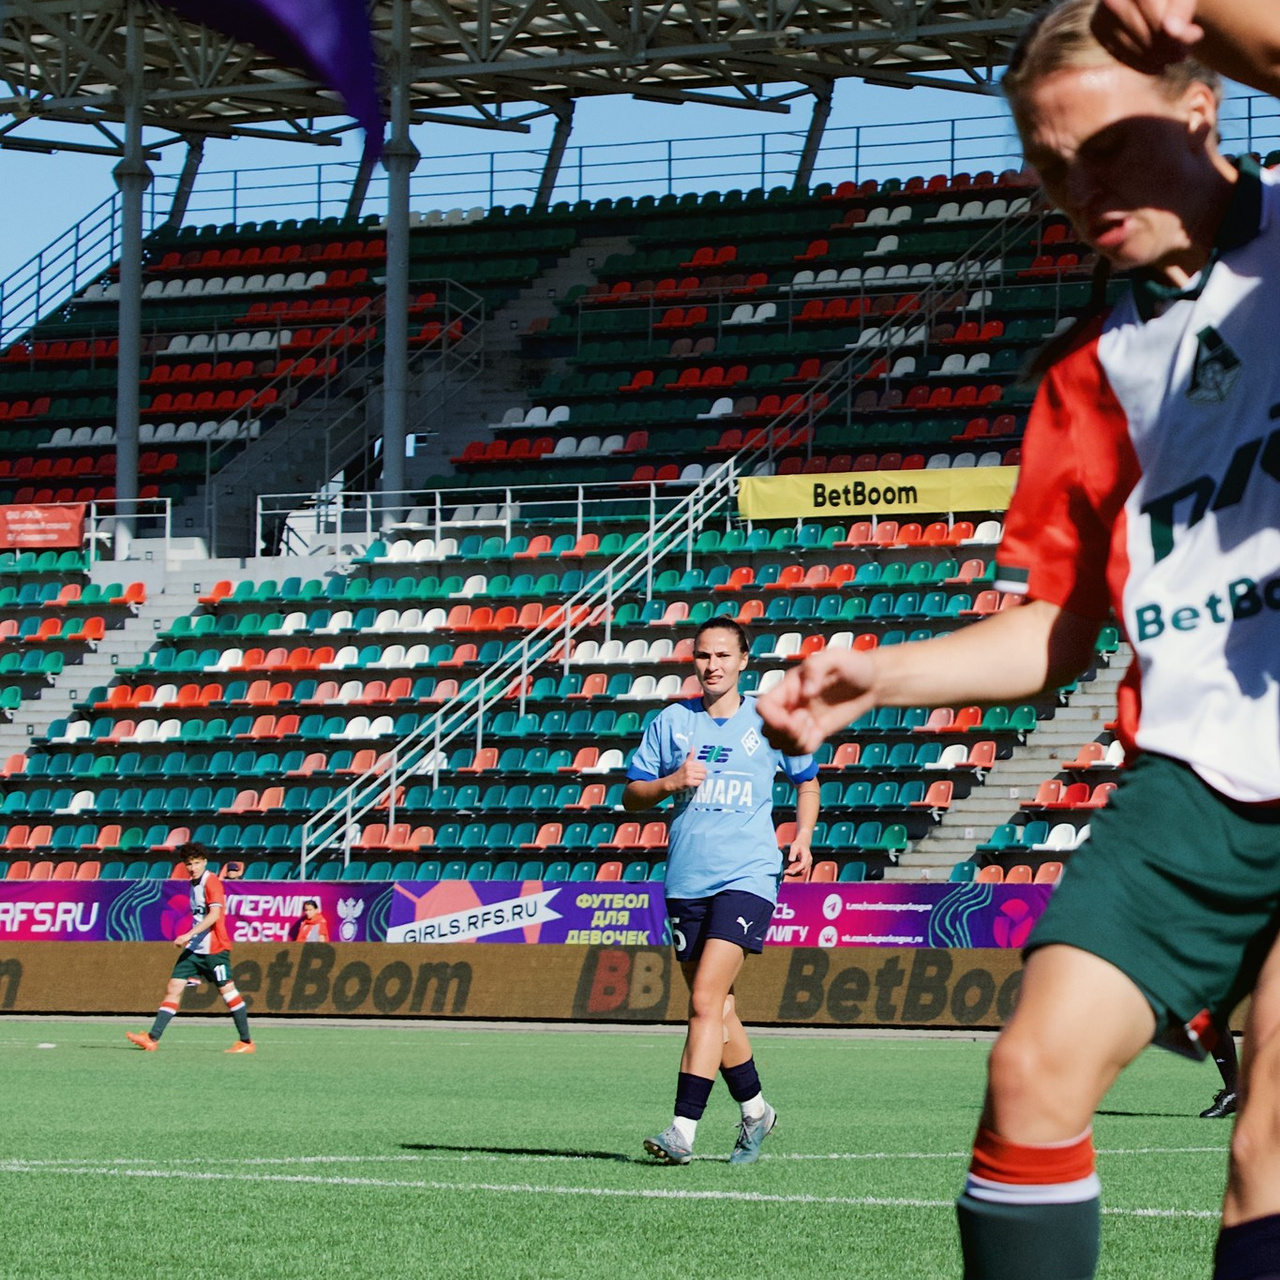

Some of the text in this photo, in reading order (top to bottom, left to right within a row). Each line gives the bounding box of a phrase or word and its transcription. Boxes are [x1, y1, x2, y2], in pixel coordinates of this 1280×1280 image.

[813, 481, 917, 507] BetBoom
[576, 893, 649, 908] ФУТБОЛ
[403, 900, 538, 942] GIRLS.RFS.RU
[591, 911, 630, 928] ДЛЯ
[233, 921, 290, 942] 2024
[565, 929, 650, 946] ДЕВОЧЕК
[213, 964, 228, 982] 11
[588, 950, 664, 1013] BB
